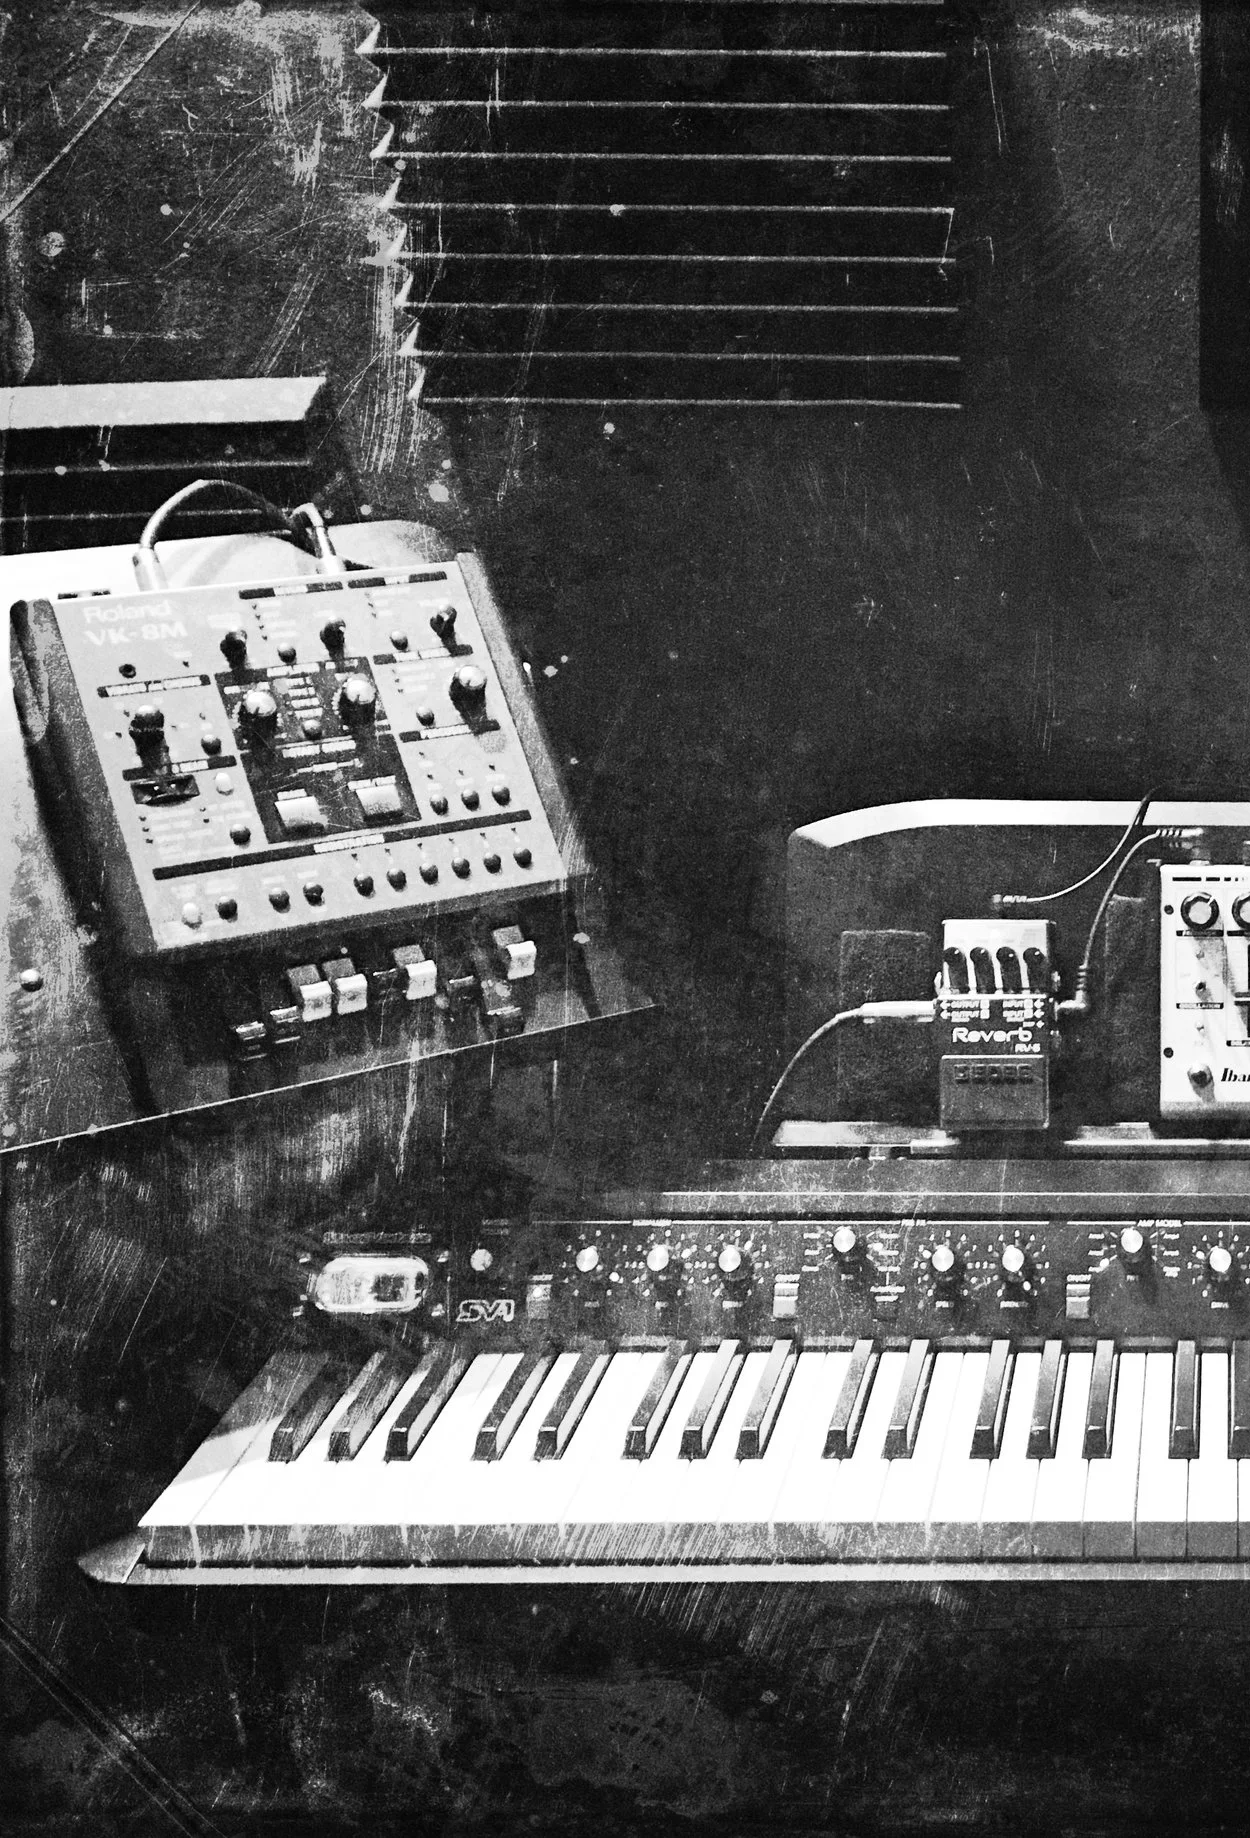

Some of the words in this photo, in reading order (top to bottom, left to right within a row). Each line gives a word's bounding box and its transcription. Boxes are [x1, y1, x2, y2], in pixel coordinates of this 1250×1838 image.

[83, 599, 172, 624] Roland
[83, 620, 188, 647] VK-8M
[952, 1027, 1033, 1043] Reverb
